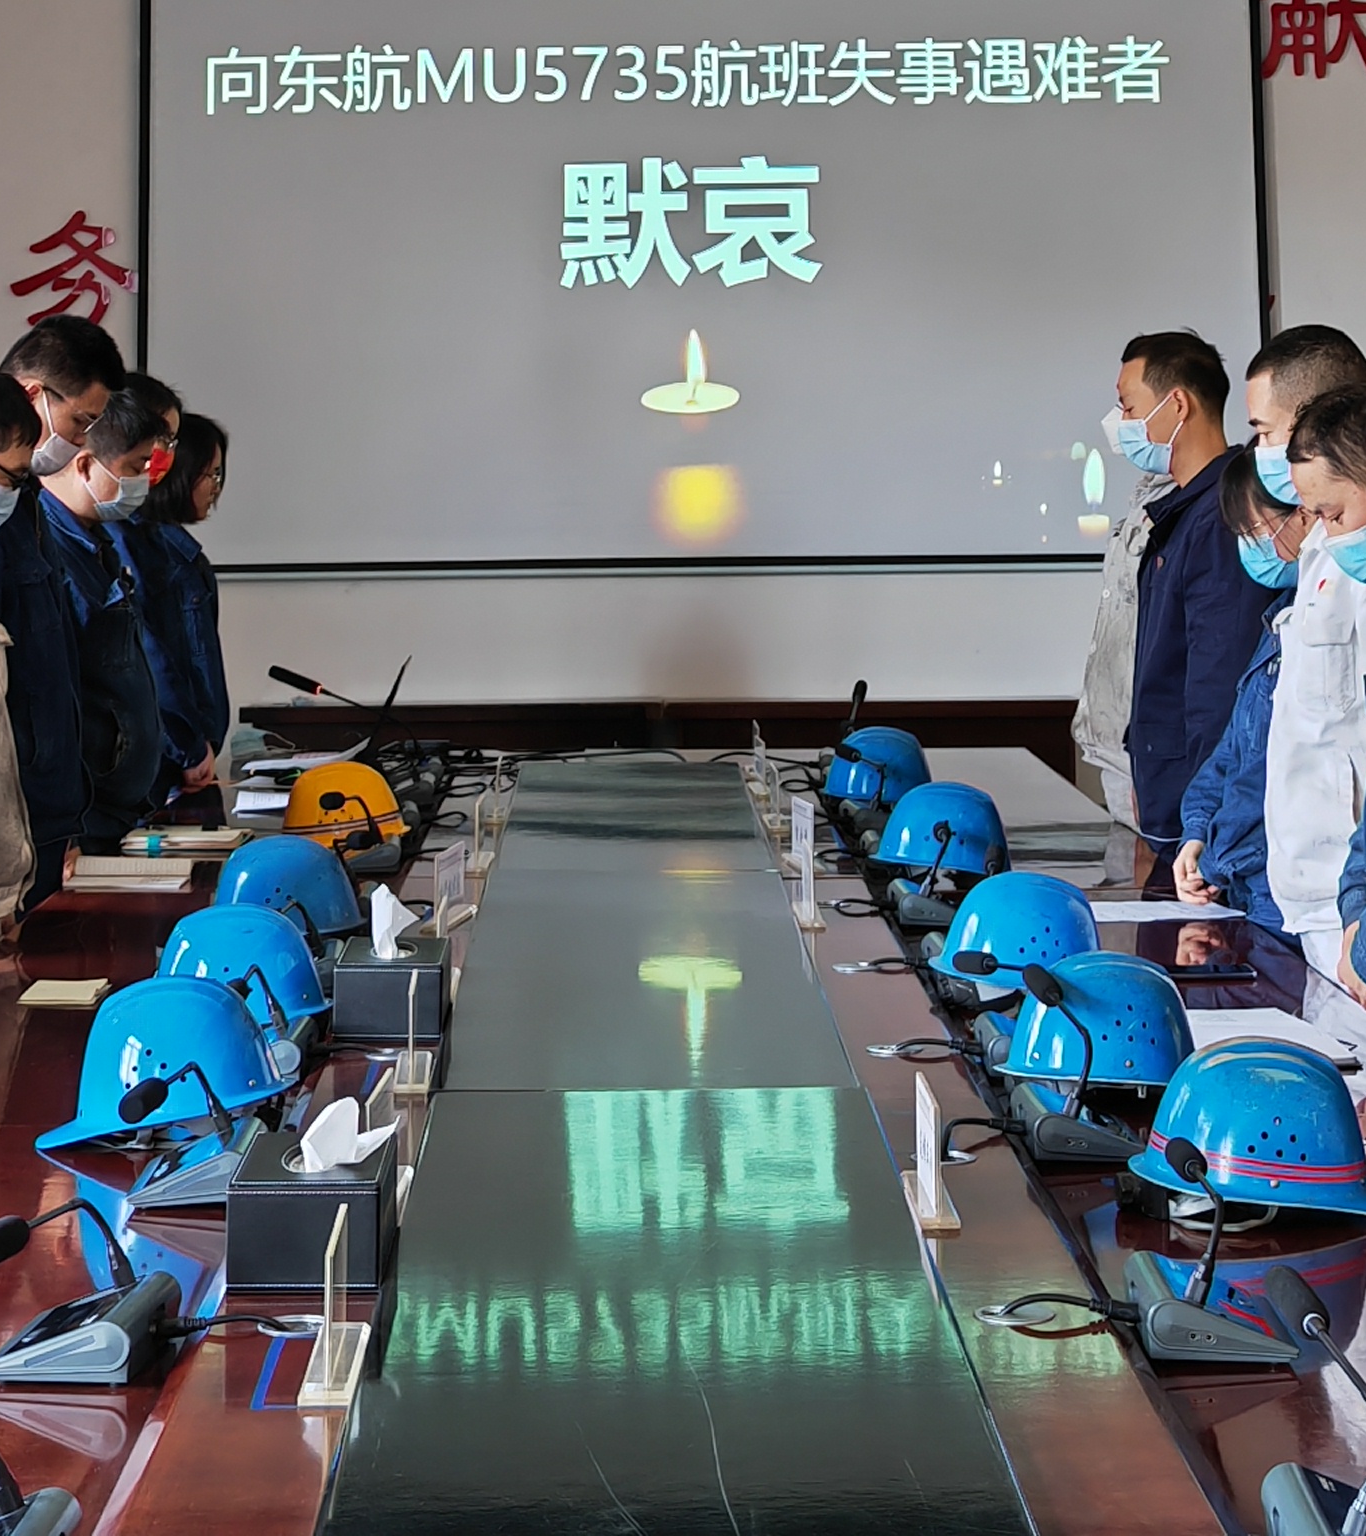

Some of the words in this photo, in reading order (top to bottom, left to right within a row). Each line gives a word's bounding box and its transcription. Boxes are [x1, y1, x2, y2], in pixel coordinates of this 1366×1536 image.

[205, 35, 1170, 116] 向东航MU5735航班失事遇难者
[559, 154, 823, 289] 默哀
